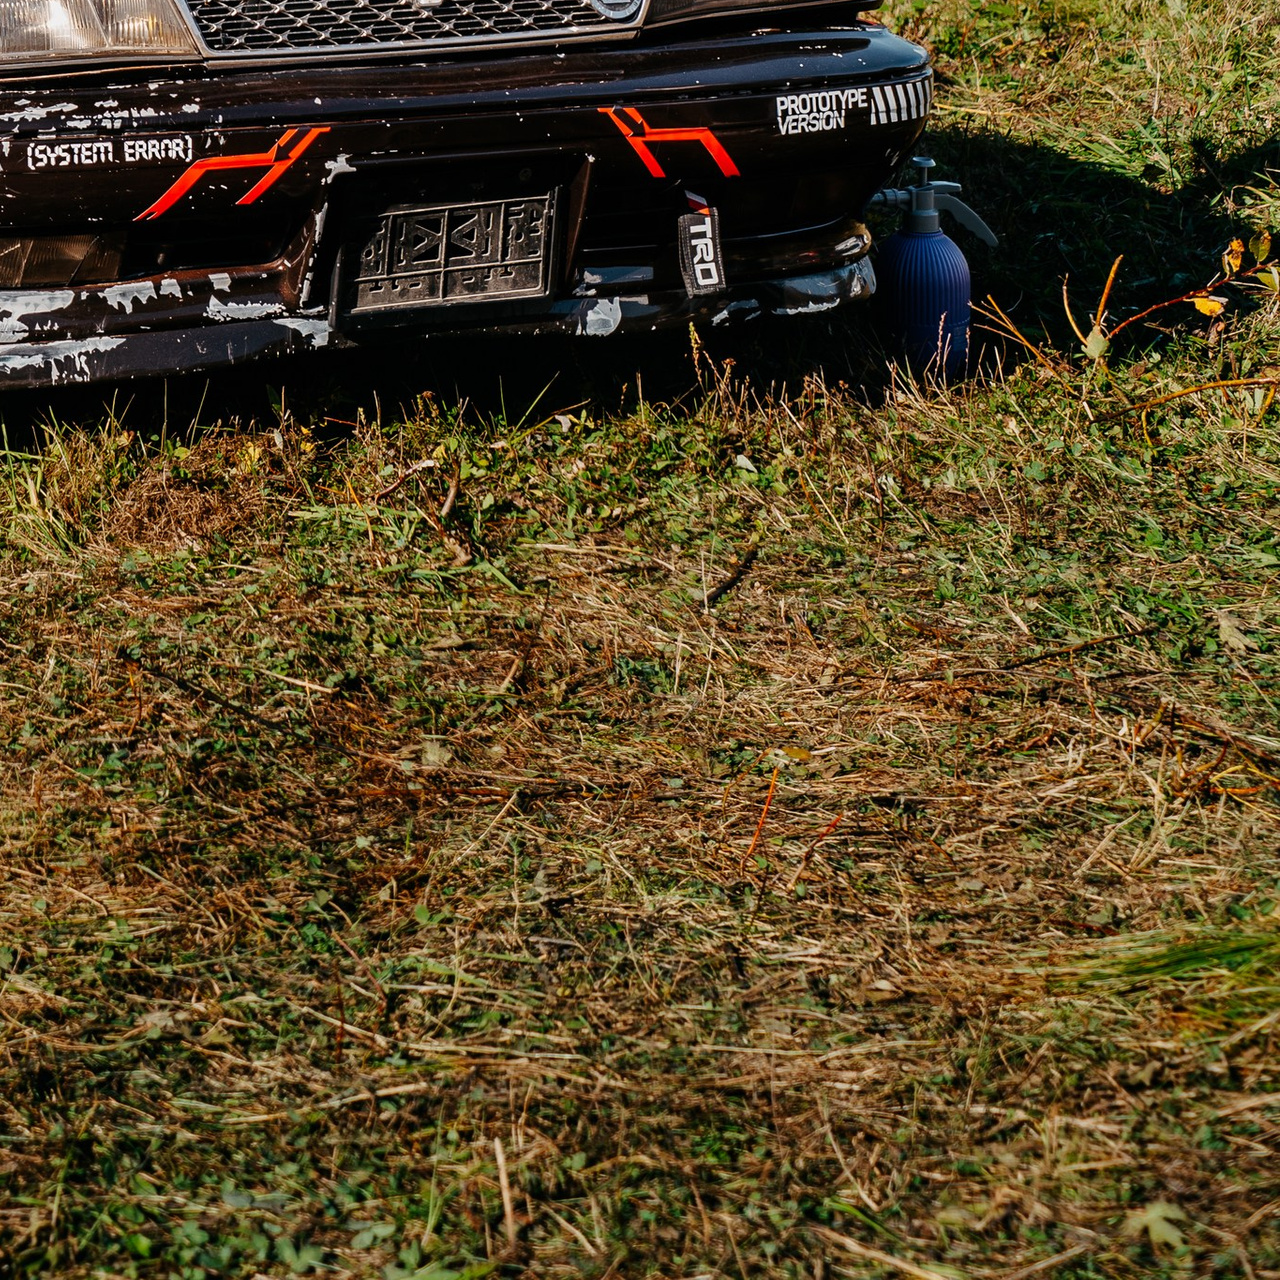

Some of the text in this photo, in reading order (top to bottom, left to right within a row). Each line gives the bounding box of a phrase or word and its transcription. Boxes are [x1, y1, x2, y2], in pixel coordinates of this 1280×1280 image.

[776, 87, 868, 116] PROTOTYPE
[777, 110, 846, 136] VERSION
[688, 217, 719, 286] TRD
